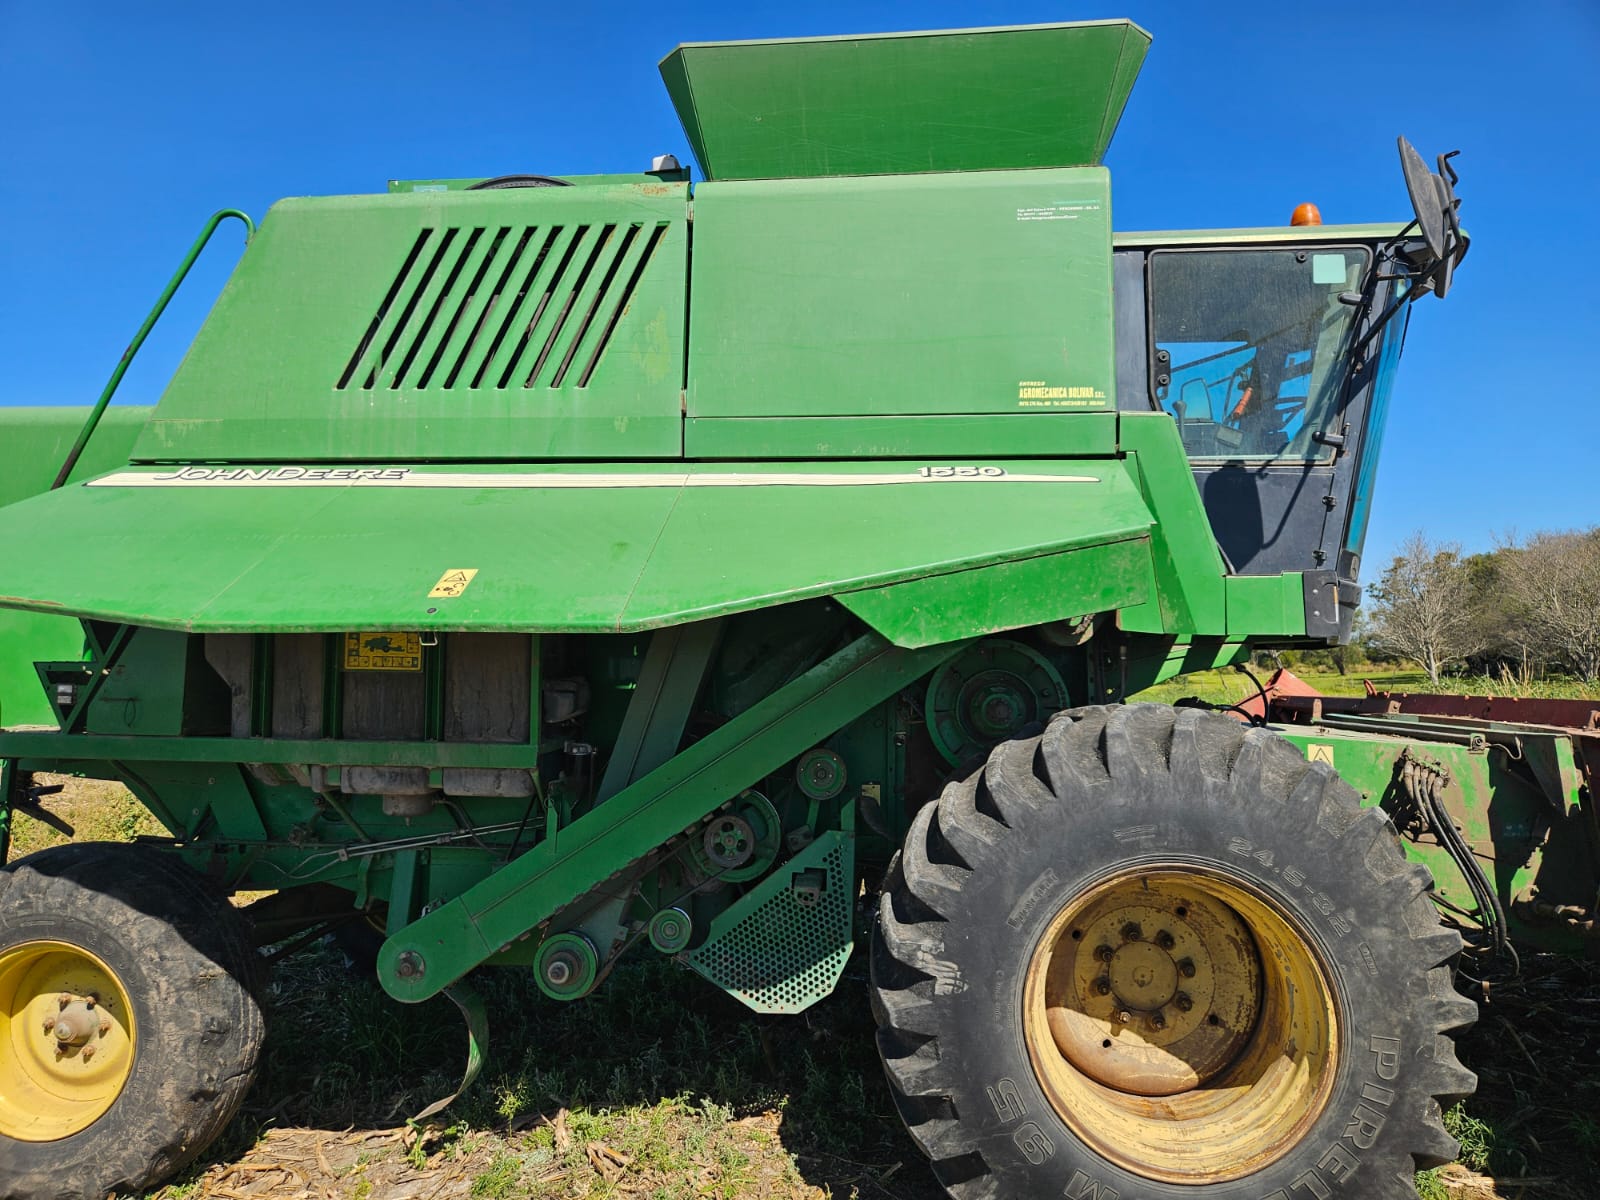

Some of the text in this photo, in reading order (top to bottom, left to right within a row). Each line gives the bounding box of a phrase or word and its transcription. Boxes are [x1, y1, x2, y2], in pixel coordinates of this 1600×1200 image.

[1019, 387, 1067, 399] AGROMECANICA
[153, 466, 411, 481] JOHN DEERE
[917, 466, 1006, 478] 1550
[1229, 836, 1351, 938] 24.5-32
[1258, 1034, 1401, 1200] PIREL
